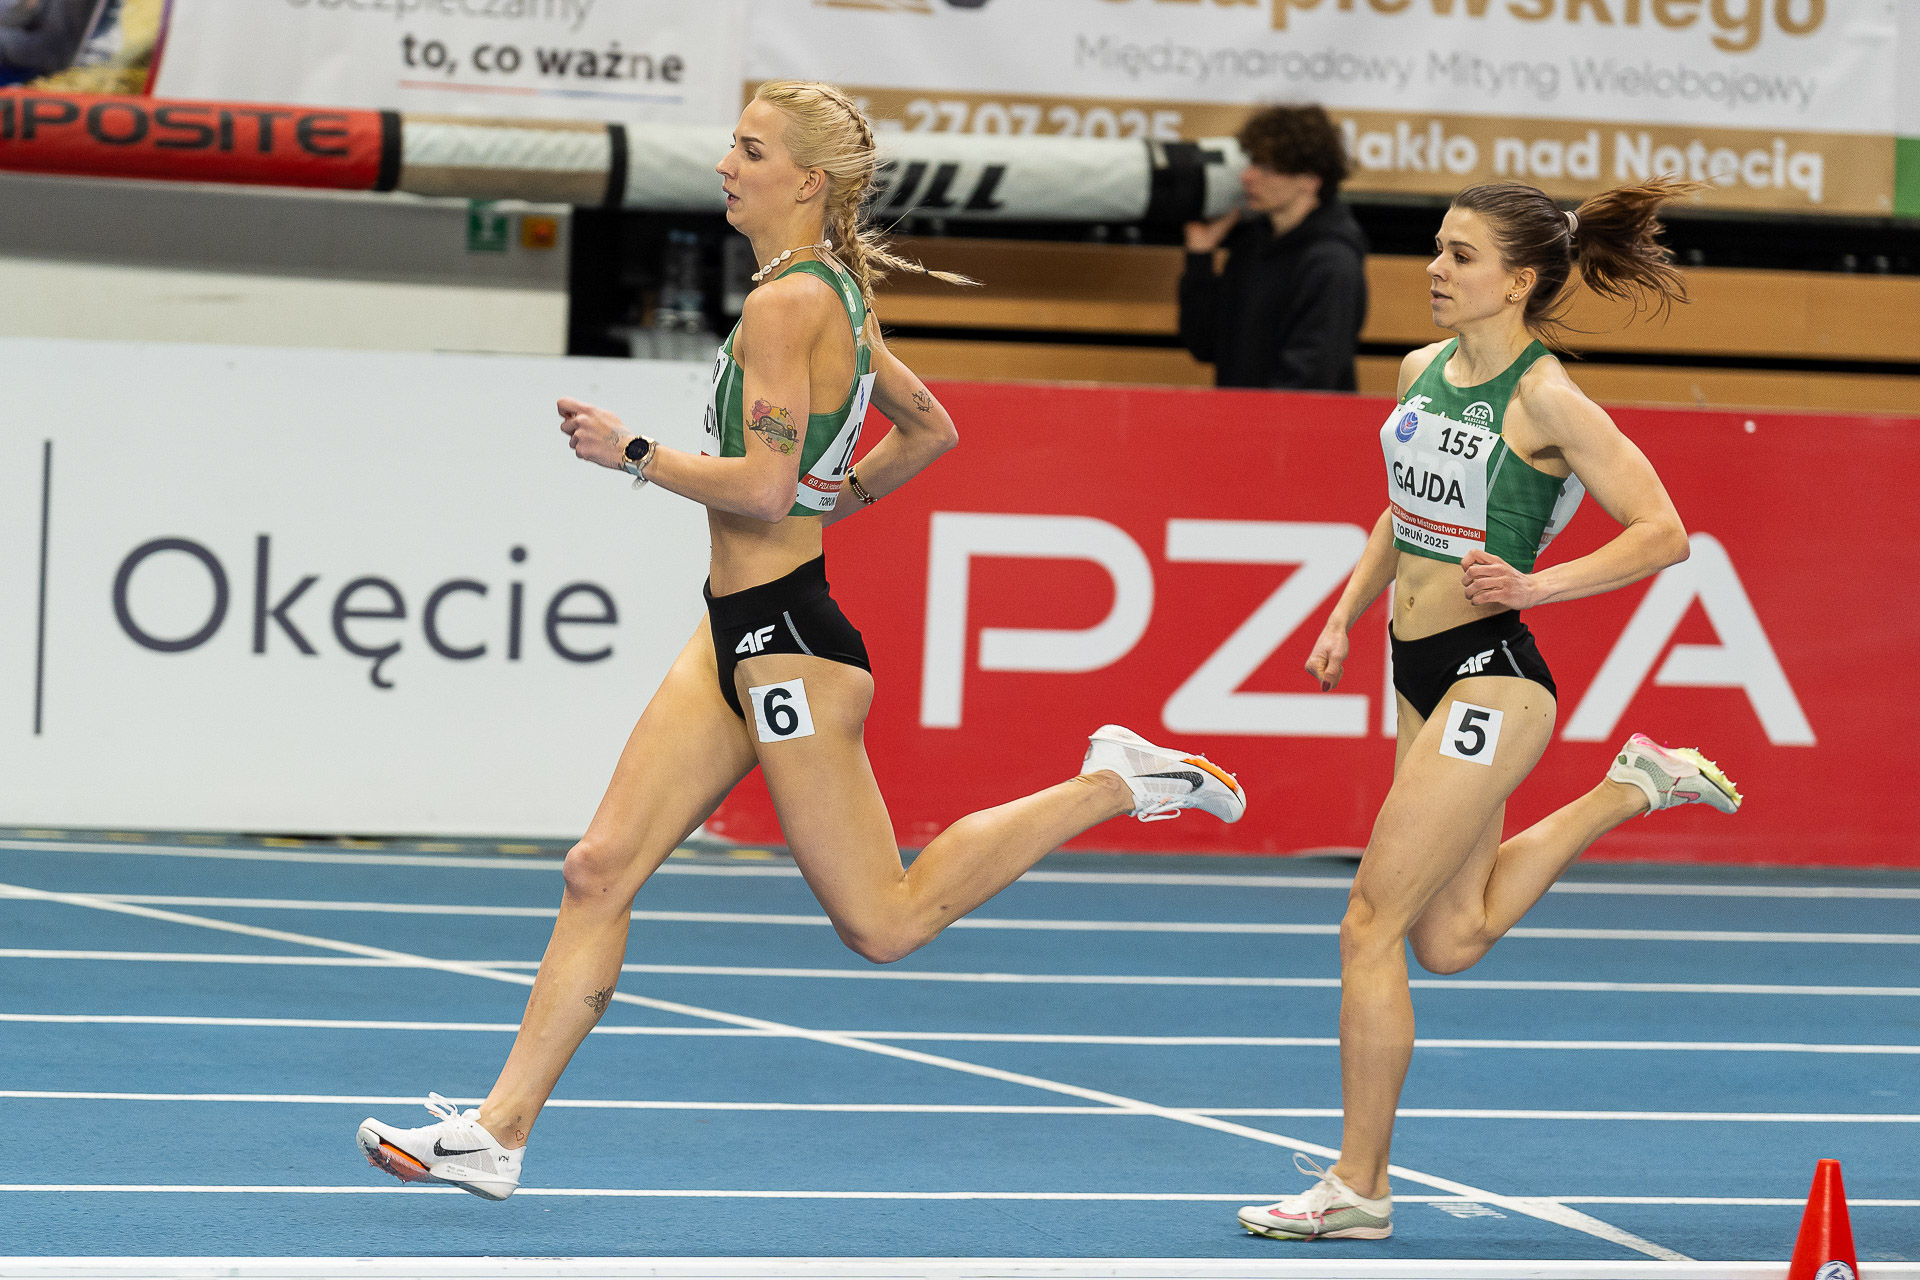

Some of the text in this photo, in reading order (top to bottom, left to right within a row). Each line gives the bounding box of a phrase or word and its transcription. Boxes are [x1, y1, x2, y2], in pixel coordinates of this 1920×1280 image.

[402, 32, 685, 83] to, co ważne
[1075, 33, 1819, 108] Międzynarodowy Mityng Wielobojowy
[1495, 130, 1601, 179] nad
[1469, 406, 1489, 420] AZS
[1437, 427, 1483, 460] 155
[1393, 460, 1466, 509] GAJDA
[1396, 522, 1449, 550] TORUŃ 2025
[1417, 517, 1457, 535] Mistrzostwa
[1458, 527, 1481, 539] Polski
[112, 532, 620, 689] Okęcie
[918, 511, 1818, 747] PZA
[763, 687, 799, 736] 6
[1454, 708, 1491, 757] 5
